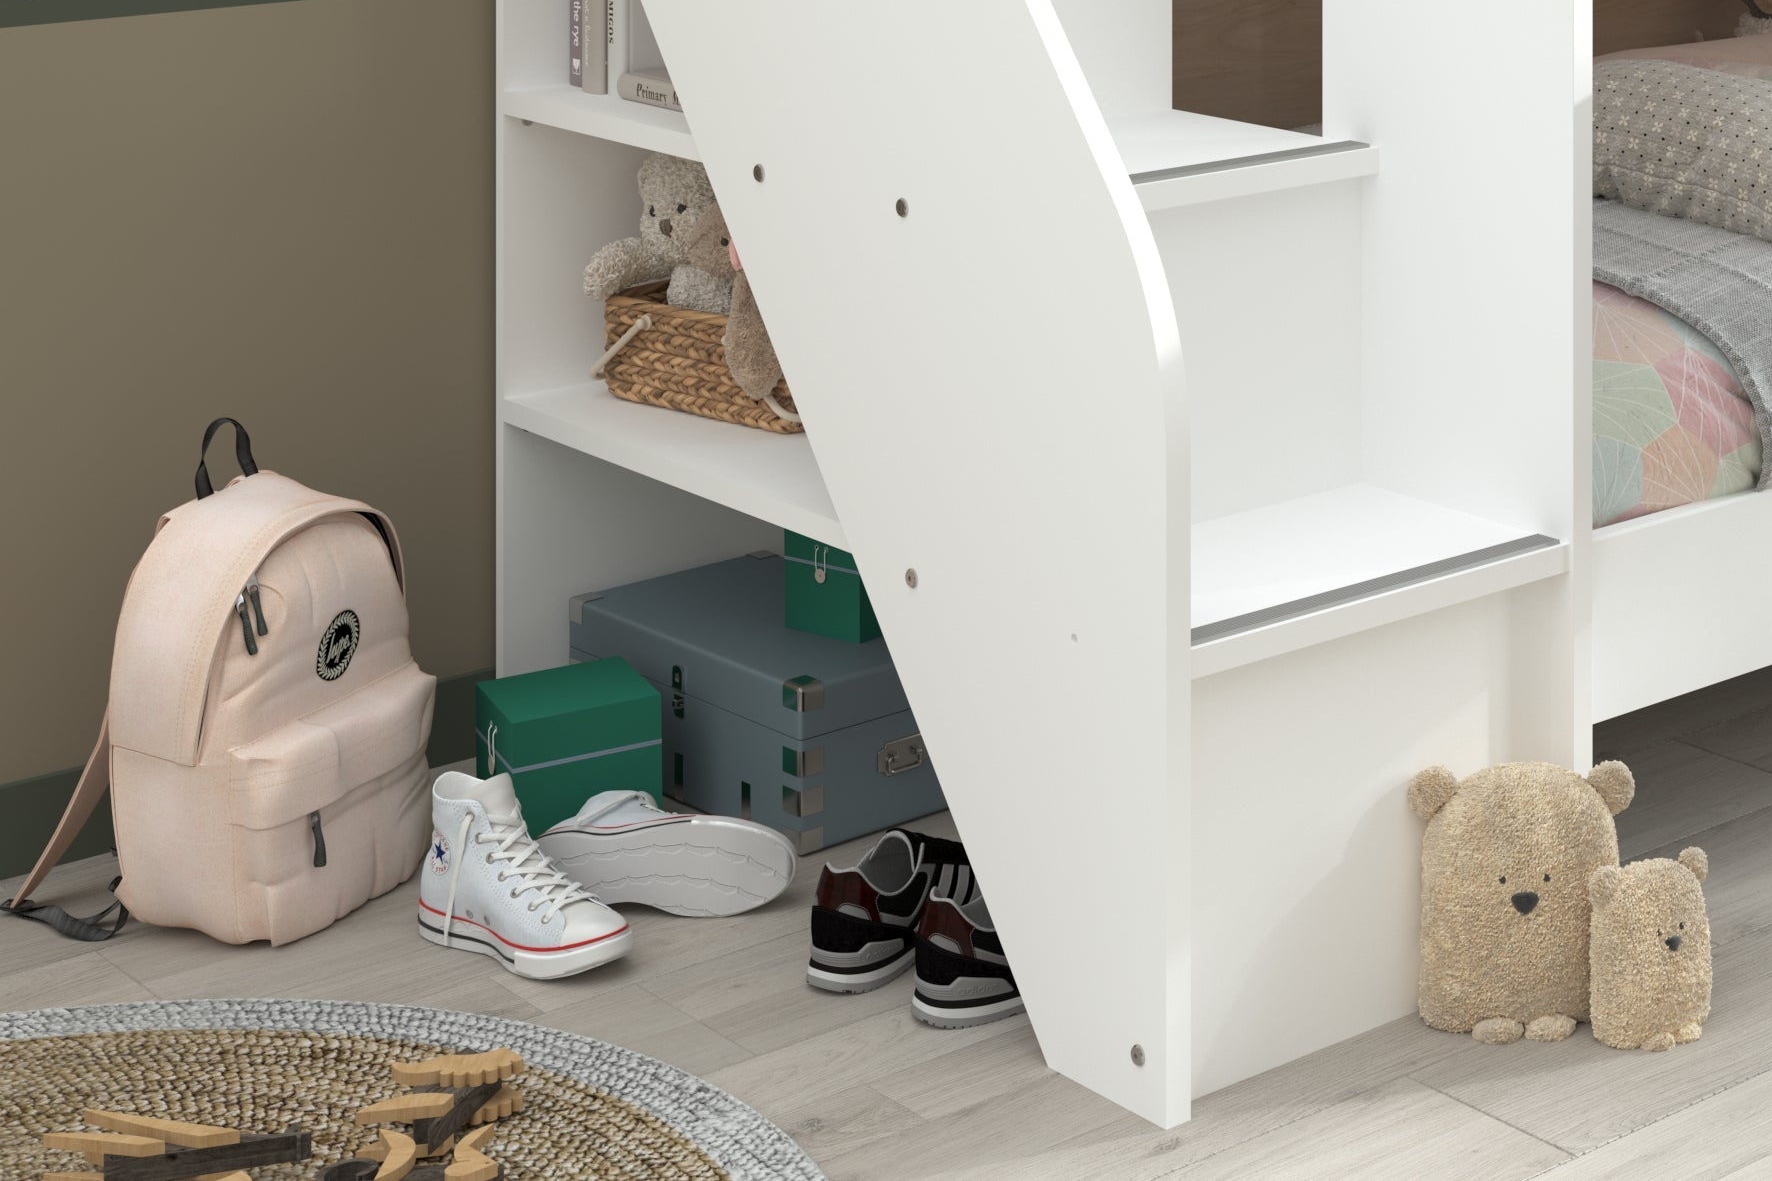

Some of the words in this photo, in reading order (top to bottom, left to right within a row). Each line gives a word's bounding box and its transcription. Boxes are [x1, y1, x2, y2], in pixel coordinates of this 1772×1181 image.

[573, 1, 582, 22] the
[571, 25, 580, 47] rye
[636, 82, 668, 107] Primary
